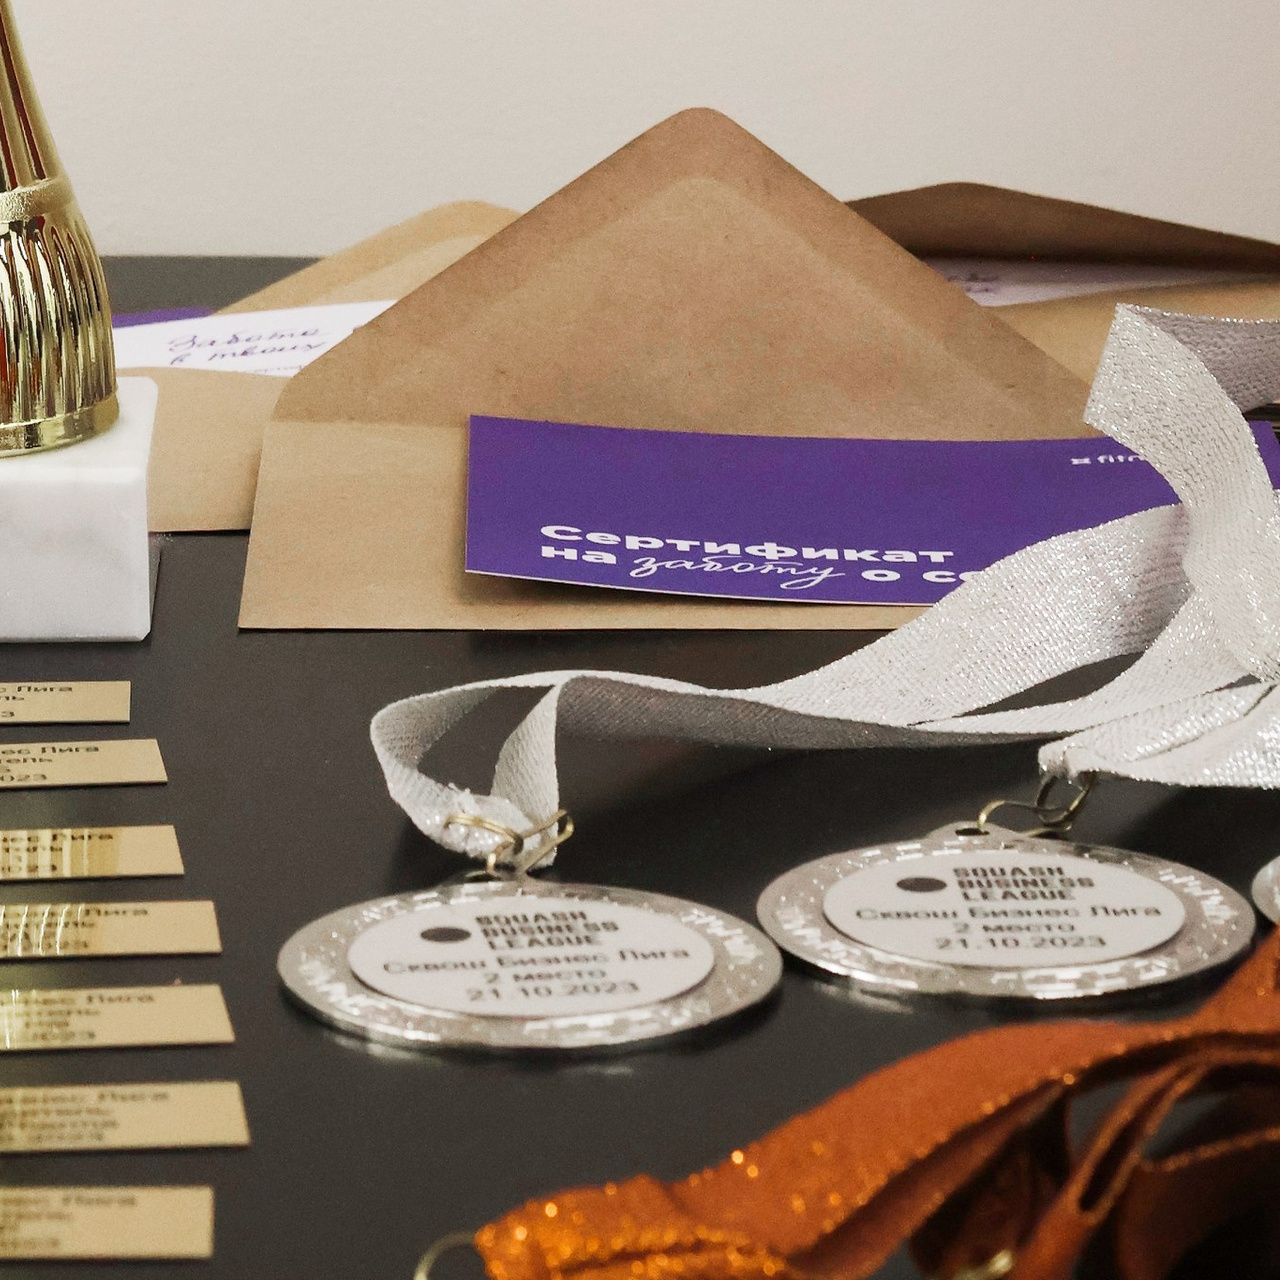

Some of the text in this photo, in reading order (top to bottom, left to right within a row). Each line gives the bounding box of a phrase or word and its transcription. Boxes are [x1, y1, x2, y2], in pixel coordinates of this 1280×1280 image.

[539, 524, 955, 565] Сертификат
[540, 544, 618, 566] на
[629, 553, 846, 591] заботу
[860, 569, 901, 583] о
[952, 866, 1065, 878] SQUASH
[956, 877, 1095, 890] BUSINESS
[961, 889, 1077, 902] LEAGUE
[475, 911, 588, 925] SQUASH
[488, 935, 602, 951] LEAGUE
